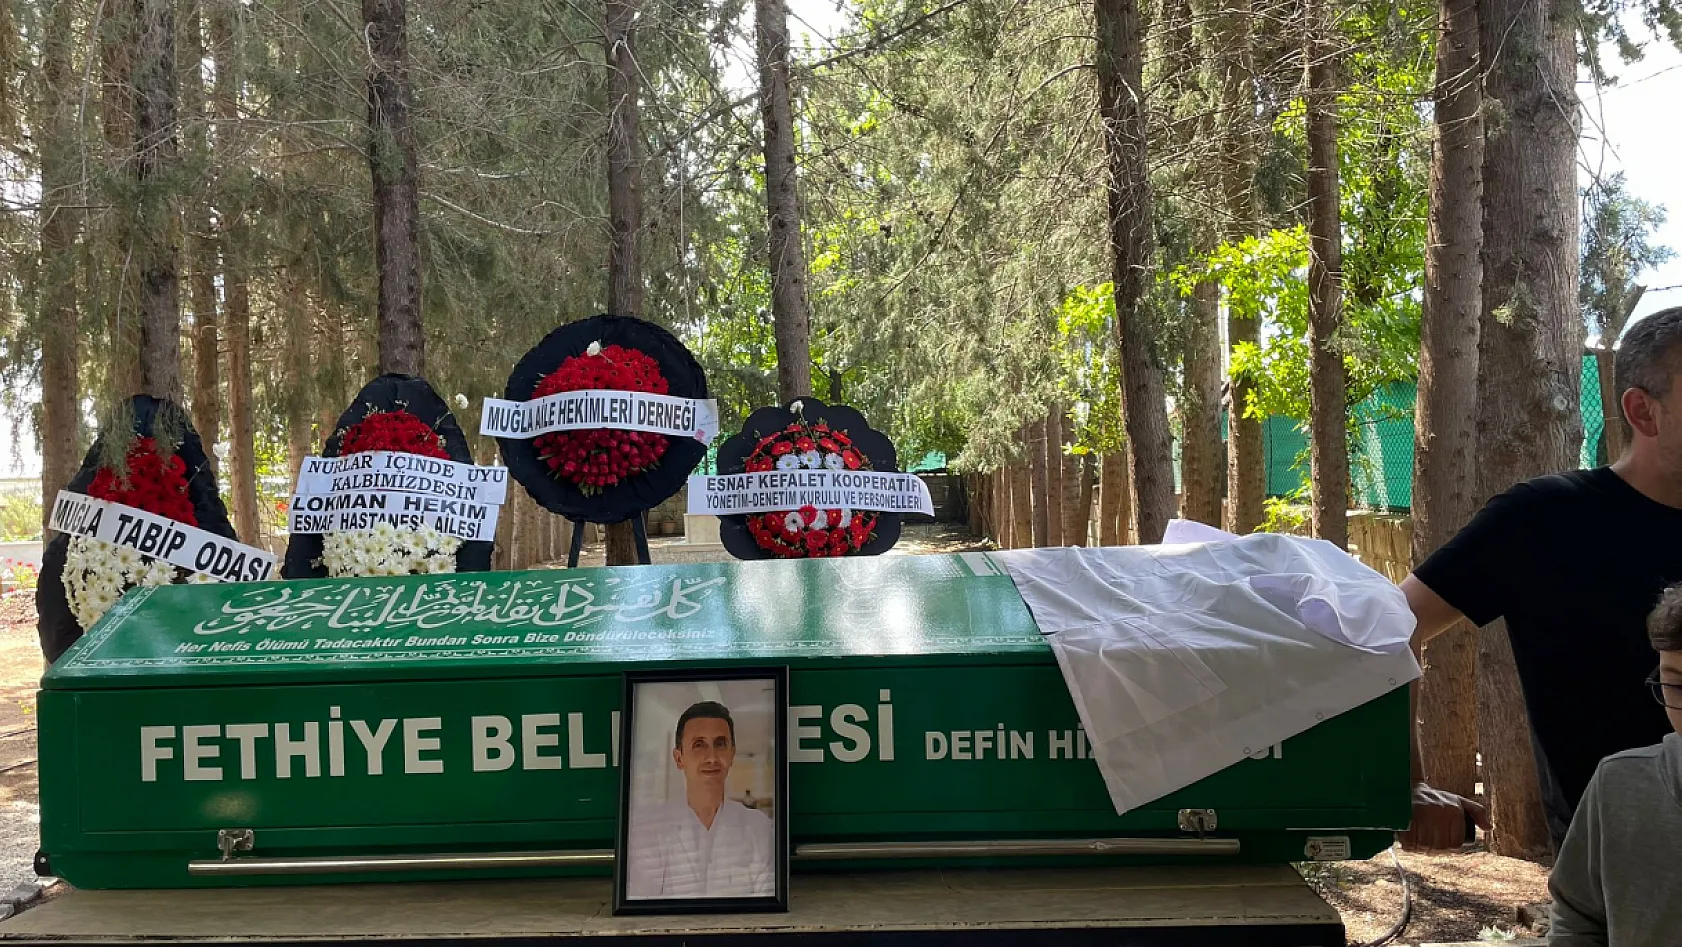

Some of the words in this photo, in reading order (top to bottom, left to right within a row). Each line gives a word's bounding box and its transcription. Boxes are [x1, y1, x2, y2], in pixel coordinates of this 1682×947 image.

[487, 404, 534, 432] MUĞLA
[535, 397, 555, 427] AİLE
[557, 391, 633, 424] HEKİMLERİ
[637, 401, 696, 431] DERNEĞİ
[307, 455, 373, 473] NURLAR
[386, 454, 455, 478] İÇİNDE
[467, 468, 506, 483] UYU
[706, 475, 753, 491] ESNAF
[758, 473, 827, 489] KEFALET
[330, 468, 477, 501] KALBİMİZDESİN
[292, 494, 387, 511] LOKMAN
[706, 488, 797, 509] YÖNETİM-DENETİM
[800, 491, 841, 505] KURULU
[843, 492, 856, 505] VE
[858, 492, 922, 509] PERSONELLERİ
[294, 513, 335, 531] ESNAF
[434, 513, 482, 539] AİLESİ
[113, 513, 187, 559] TABİP
[195, 541, 272, 581] ODASI
[174, 641, 205, 653] Her
[207, 640, 251, 653] Nefis
[255, 637, 309, 650] Ölümü
[313, 638, 401, 649] Tadacaktır
[404, 635, 466, 647] Bundan
[471, 633, 519, 645] Sonra
[523, 632, 559, 643] Bize
[140, 706, 445, 782] FETHİYE
[471, 688, 896, 773] BELESİ
[925, 723, 1034, 760] DEFİN
